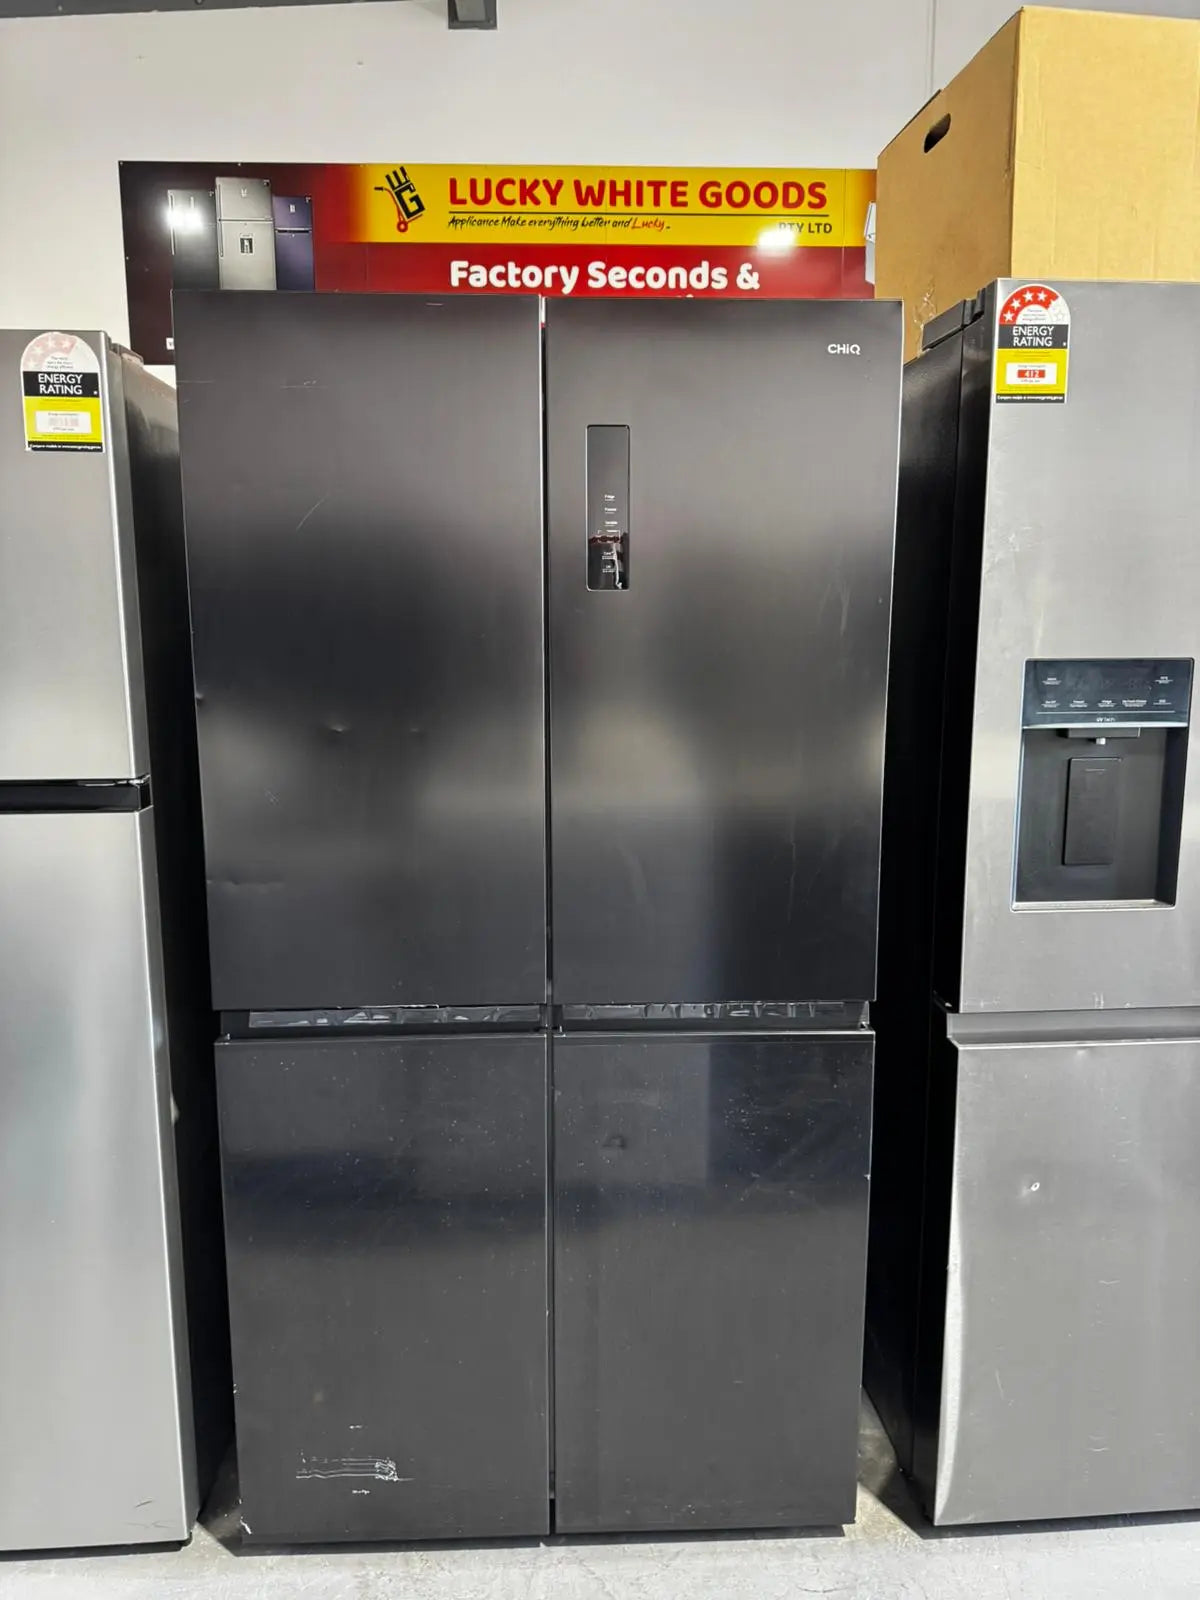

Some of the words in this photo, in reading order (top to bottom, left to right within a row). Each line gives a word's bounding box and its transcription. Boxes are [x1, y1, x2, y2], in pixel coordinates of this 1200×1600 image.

[449, 178, 564, 206] LUCKY
[574, 179, 689, 208] WHITE
[699, 180, 828, 210] GOODS
[501, 215, 526, 227] Make
[528, 216, 579, 231] everything
[581, 217, 609, 227] better
[611, 217, 631, 228] and
[808, 222, 833, 234] LTD
[450, 260, 579, 294] Factory
[588, 260, 728, 289] Seconds
[737, 263, 760, 290] &
[1012, 326, 1054, 336] ENERGY
[1013, 337, 1053, 347] RATING
[38, 373, 83, 384] ENERGY
[39, 384, 83, 395] RATING
